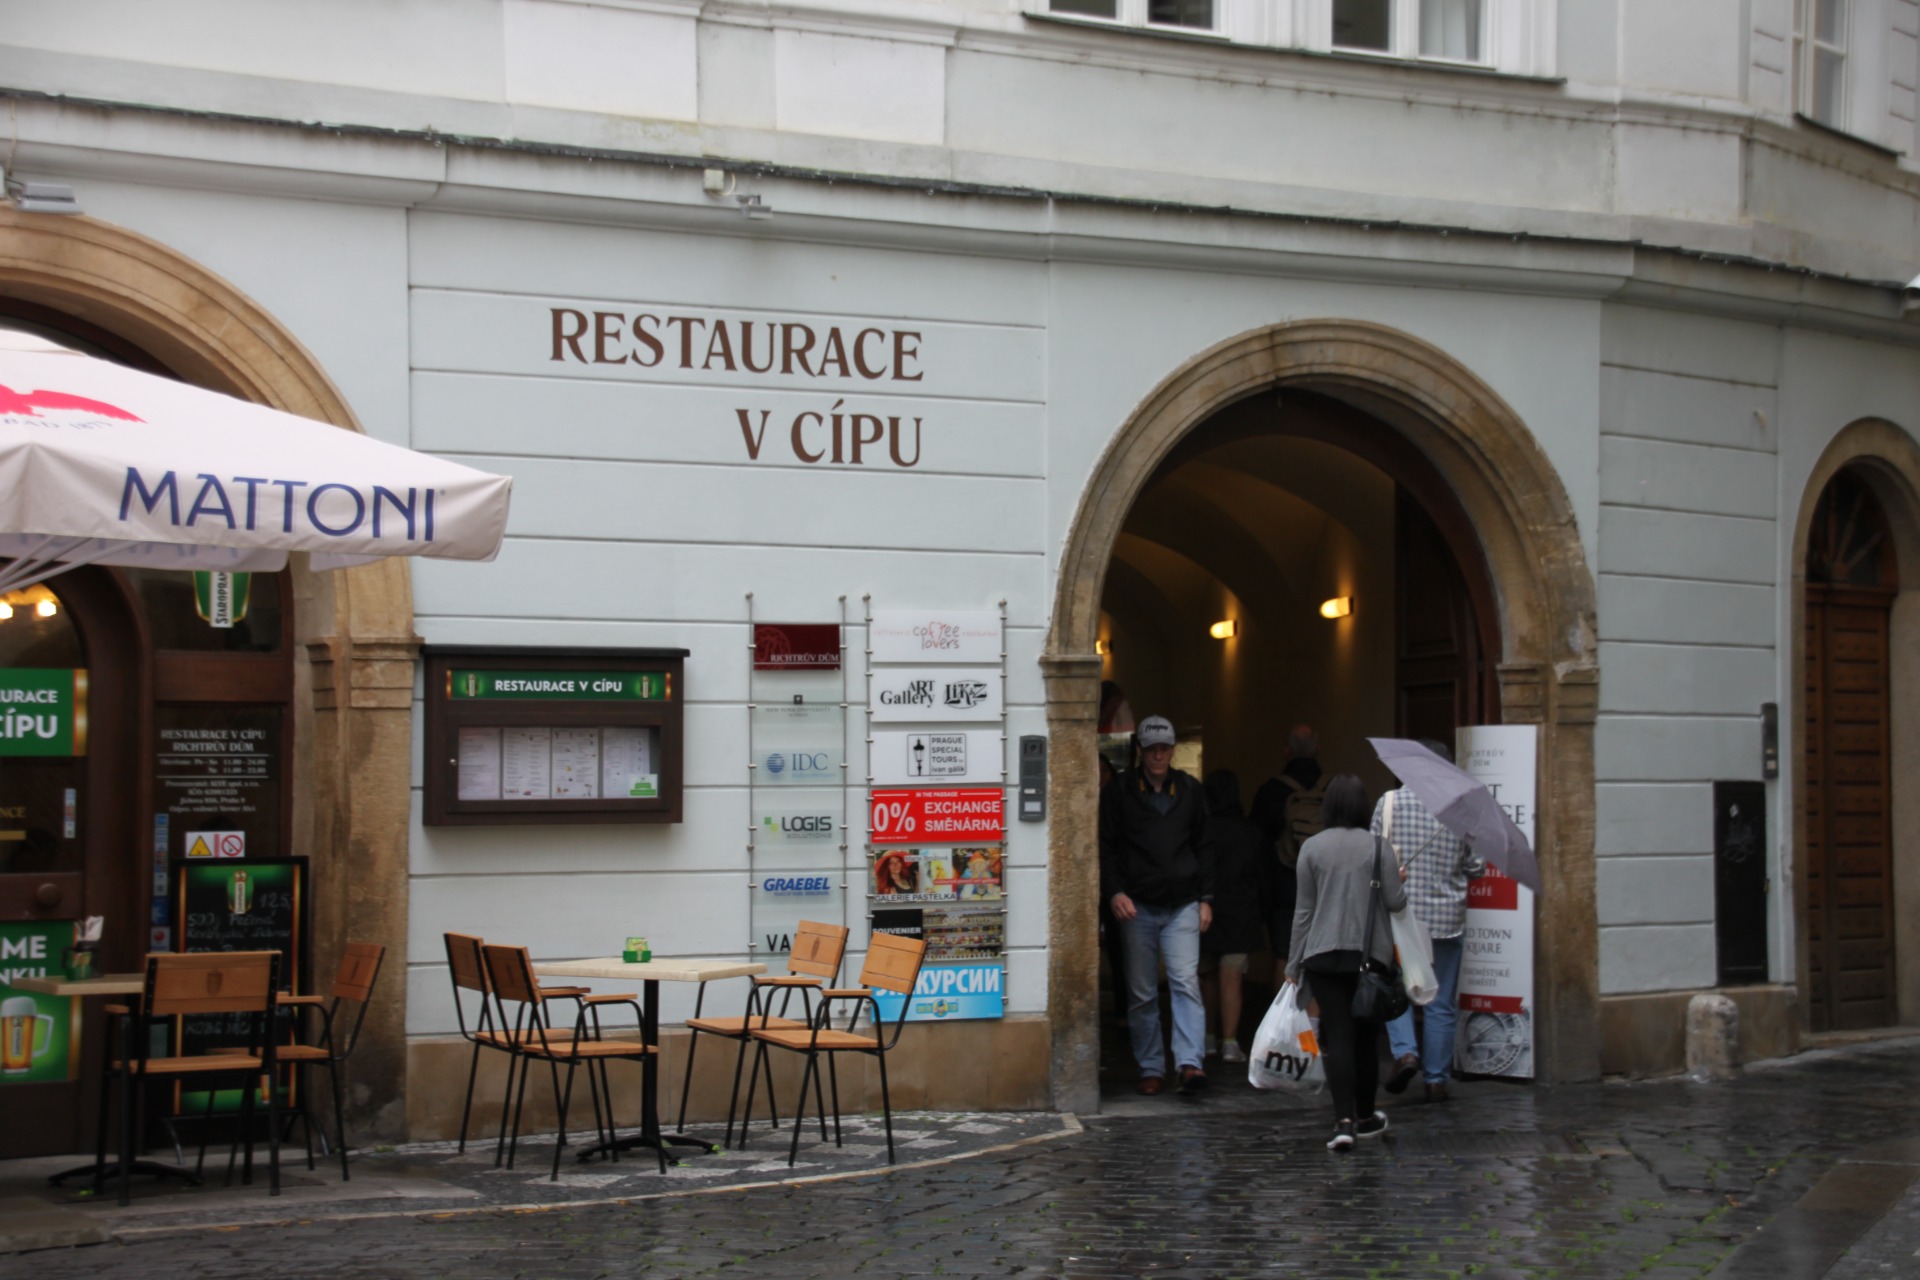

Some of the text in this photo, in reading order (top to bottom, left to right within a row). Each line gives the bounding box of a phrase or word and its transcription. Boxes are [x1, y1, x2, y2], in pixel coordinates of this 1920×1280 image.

[549, 307, 925, 382] RESTAURACE
[734, 398, 924, 468] V CÍPU
[119, 466, 435, 543] MATTONI
[495, 678, 622, 693] RESTAURACE V CÍPU
[908, 680, 935, 695] ART
[0, 689, 59, 704] URACE
[880, 690, 935, 708] Gallery
[931, 746, 964, 754] SPECIAL
[792, 752, 829, 771] IDC
[781, 816, 832, 832] LOGIS
[873, 801, 1001, 832] 0% EXCHANGE
[924, 817, 1001, 832] SMĚNÁRNA
[763, 877, 831, 892] GRAEBEL
[1470, 884, 1493, 897] CAFÉ
[874, 893, 956, 902] GALERIE PASTELKA
[1477, 928, 1512, 940] TOWN
[766, 933, 797, 952] VA
[876, 968, 1000, 996] КУРСИИ
[1264, 1051, 1309, 1082] my
